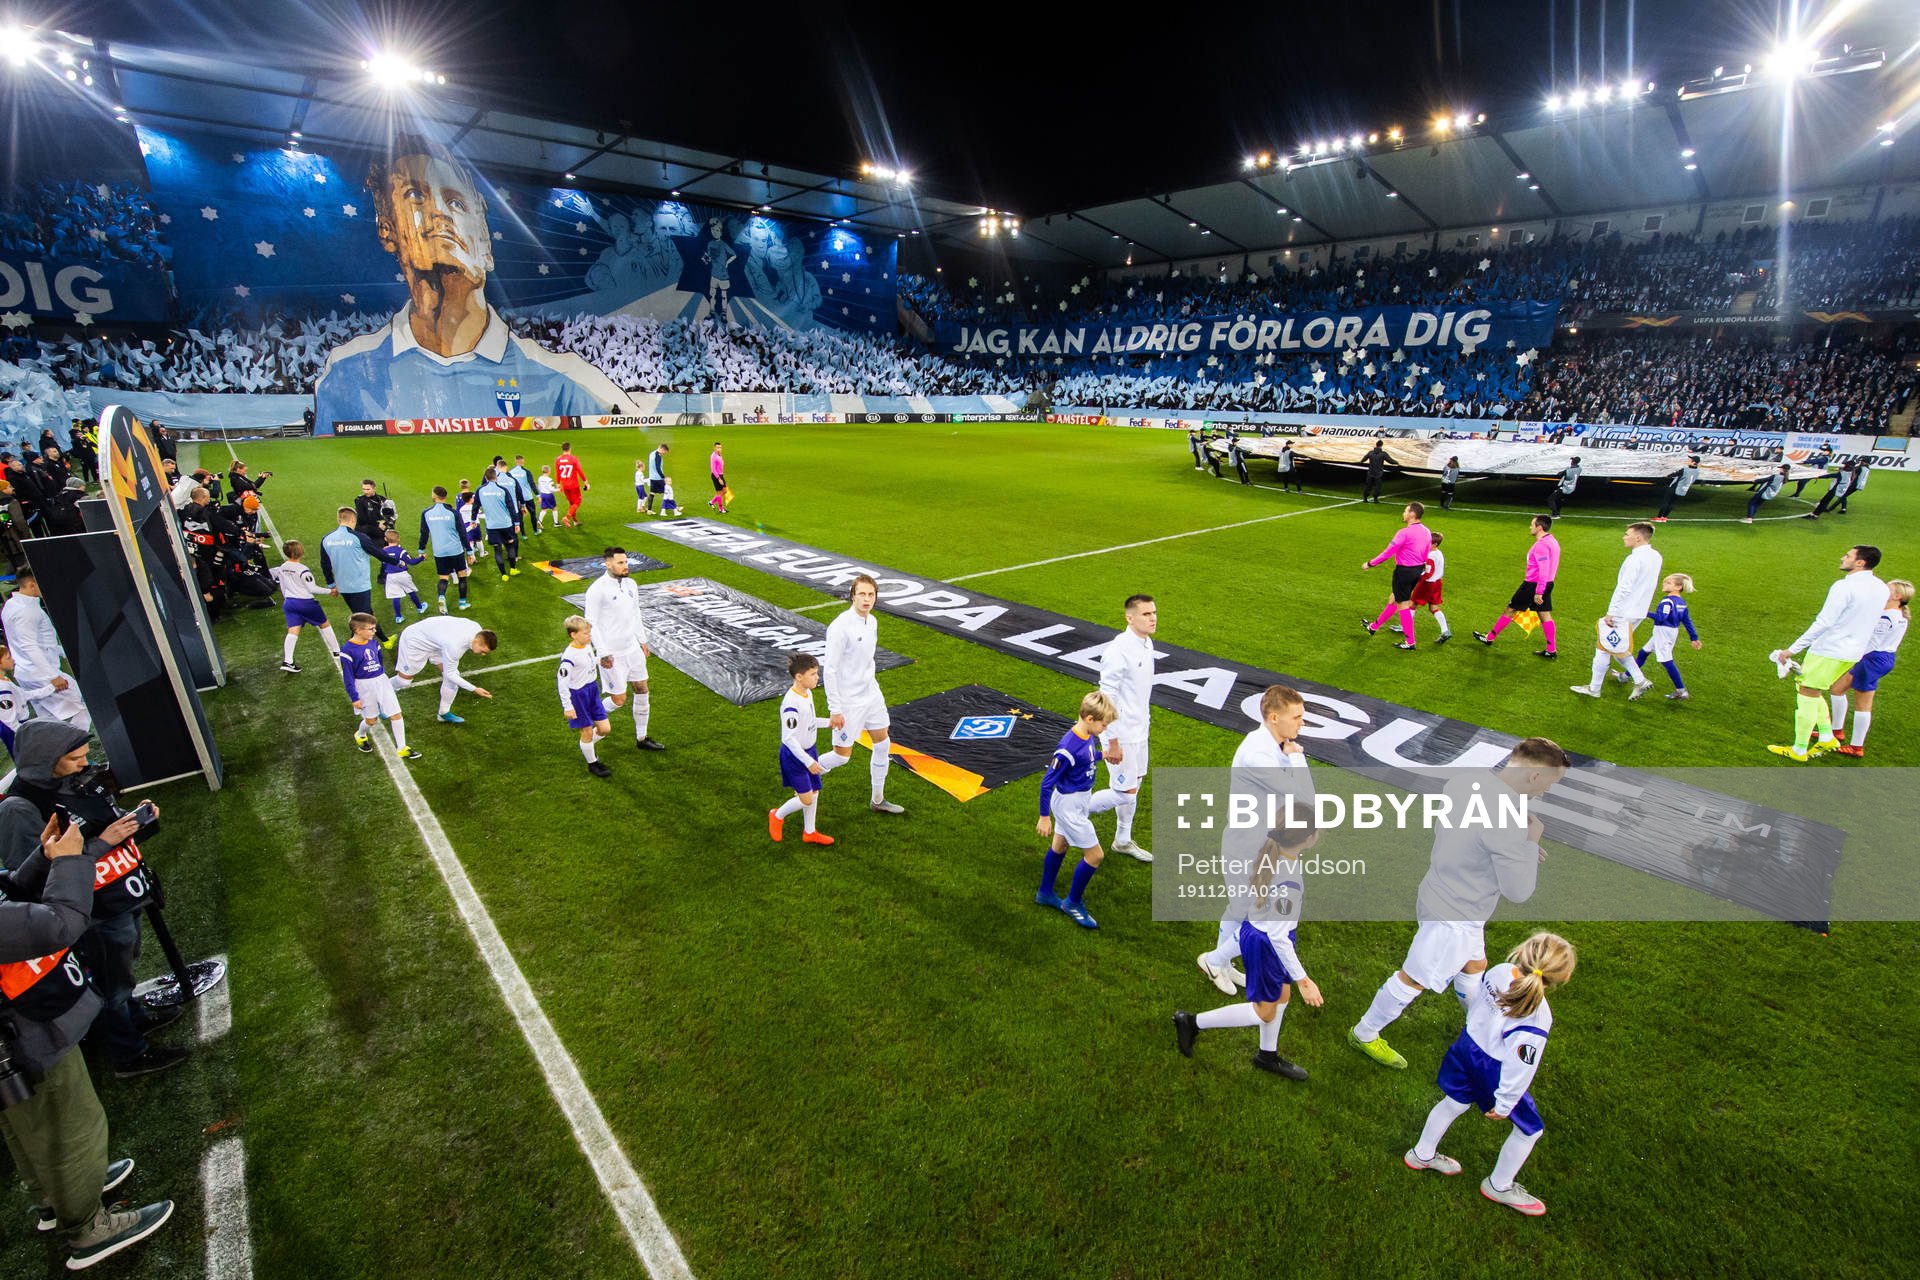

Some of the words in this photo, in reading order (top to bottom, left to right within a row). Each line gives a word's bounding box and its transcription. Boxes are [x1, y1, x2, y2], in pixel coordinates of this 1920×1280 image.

[1715, 316, 1747, 324] EUROPA
[953, 327, 1009, 353] JAG
[1018, 328, 1086, 353] KAN
[1092, 323, 1202, 353] ALDRIG
[1209, 313, 1390, 350] FÖRLORA
[1403, 309, 1492, 347] DIG
[742, 413, 769, 423] FedEx
[778, 413, 803, 423] FedEx
[812, 413, 837, 423] FedEx
[953, 413, 1002, 422] enterprise
[1056, 414, 1091, 425] AMSTEL
[1129, 417, 1152, 427] FedEx
[420, 418, 494, 433] AMSTEL
[1164, 419, 1191, 429] FedEx
[1261, 425, 1298, 433] NT-A-CAR
[1637, 442, 1689, 453] EUROPA
[559, 464, 573, 478] 27
[650, 519, 772, 553] UEFA
[744, 549, 1009, 632] EUROPA
